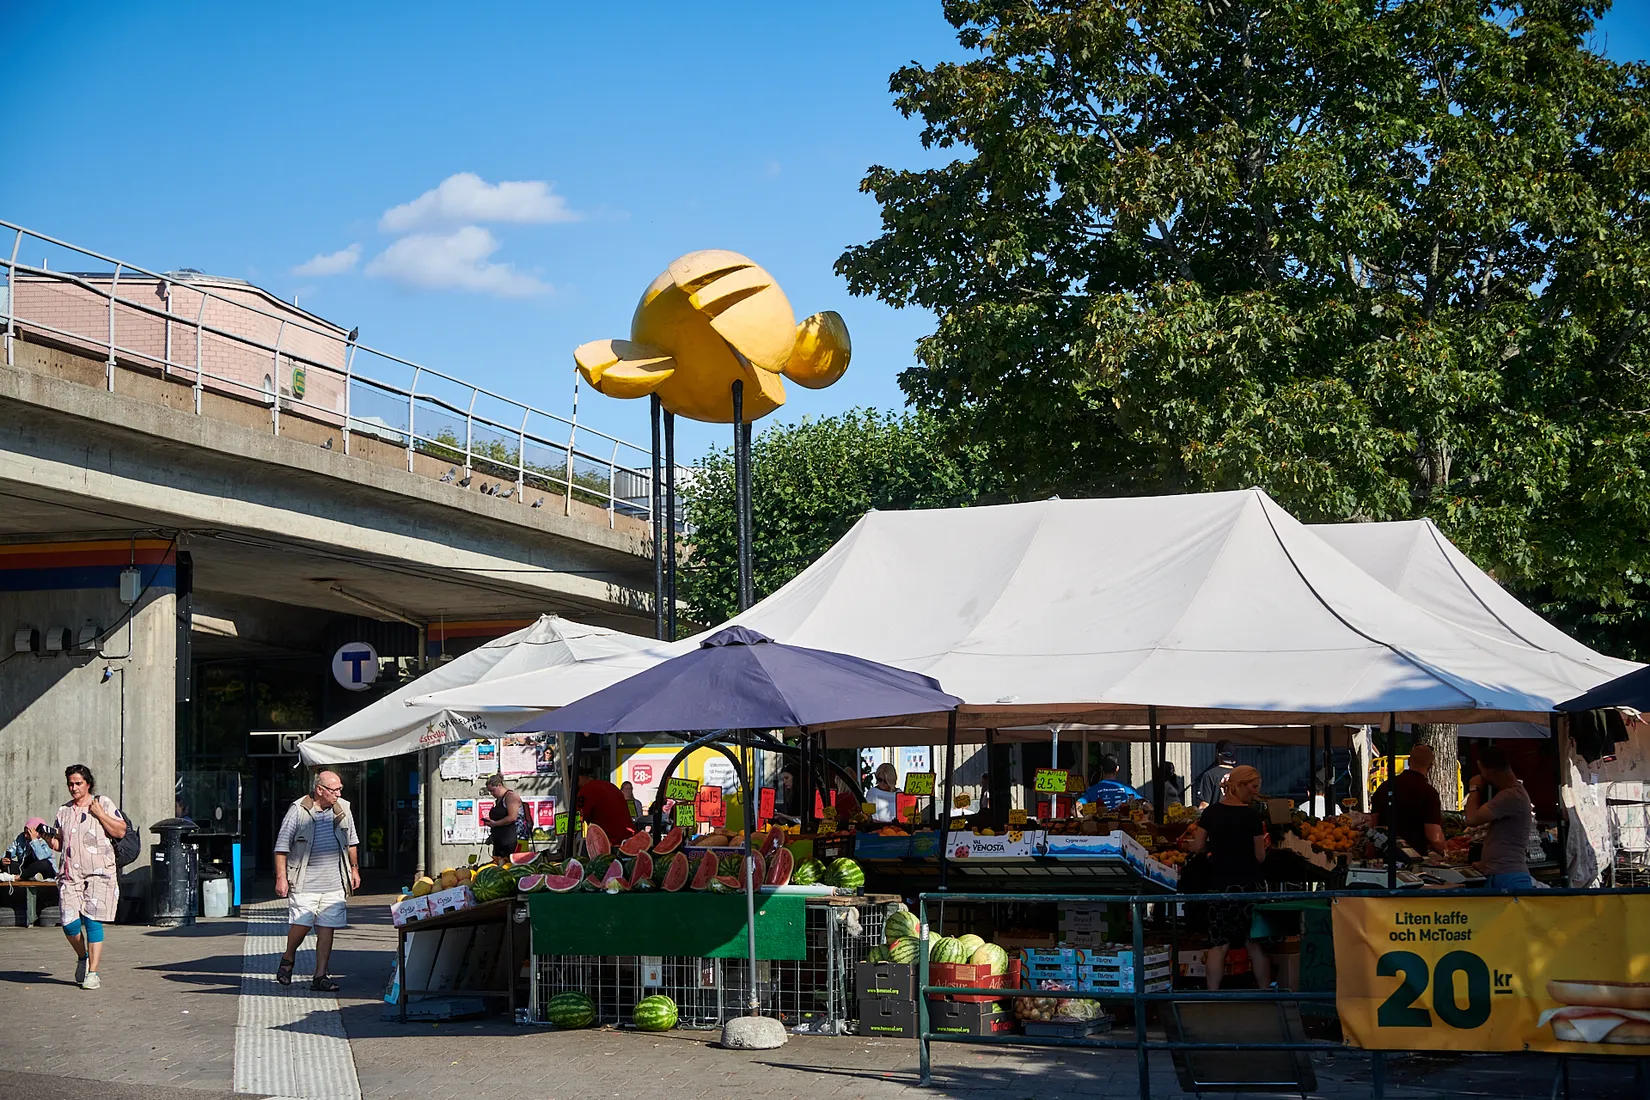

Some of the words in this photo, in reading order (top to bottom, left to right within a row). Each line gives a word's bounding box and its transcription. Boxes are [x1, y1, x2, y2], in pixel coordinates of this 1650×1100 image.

[341, 651, 371, 683] T
[286, 736, 298, 750] T
[633, 770, 652, 782] 28:-
[972, 844, 1005, 852] VENOSTA
[1395, 912, 1431, 925] Liten
[1434, 911, 1468, 925] kaffe
[1389, 928, 1416, 941] och
[1419, 928, 1472, 942] McToast
[1376, 950, 1492, 1029] 20
[1494, 969, 1513, 987] kr
